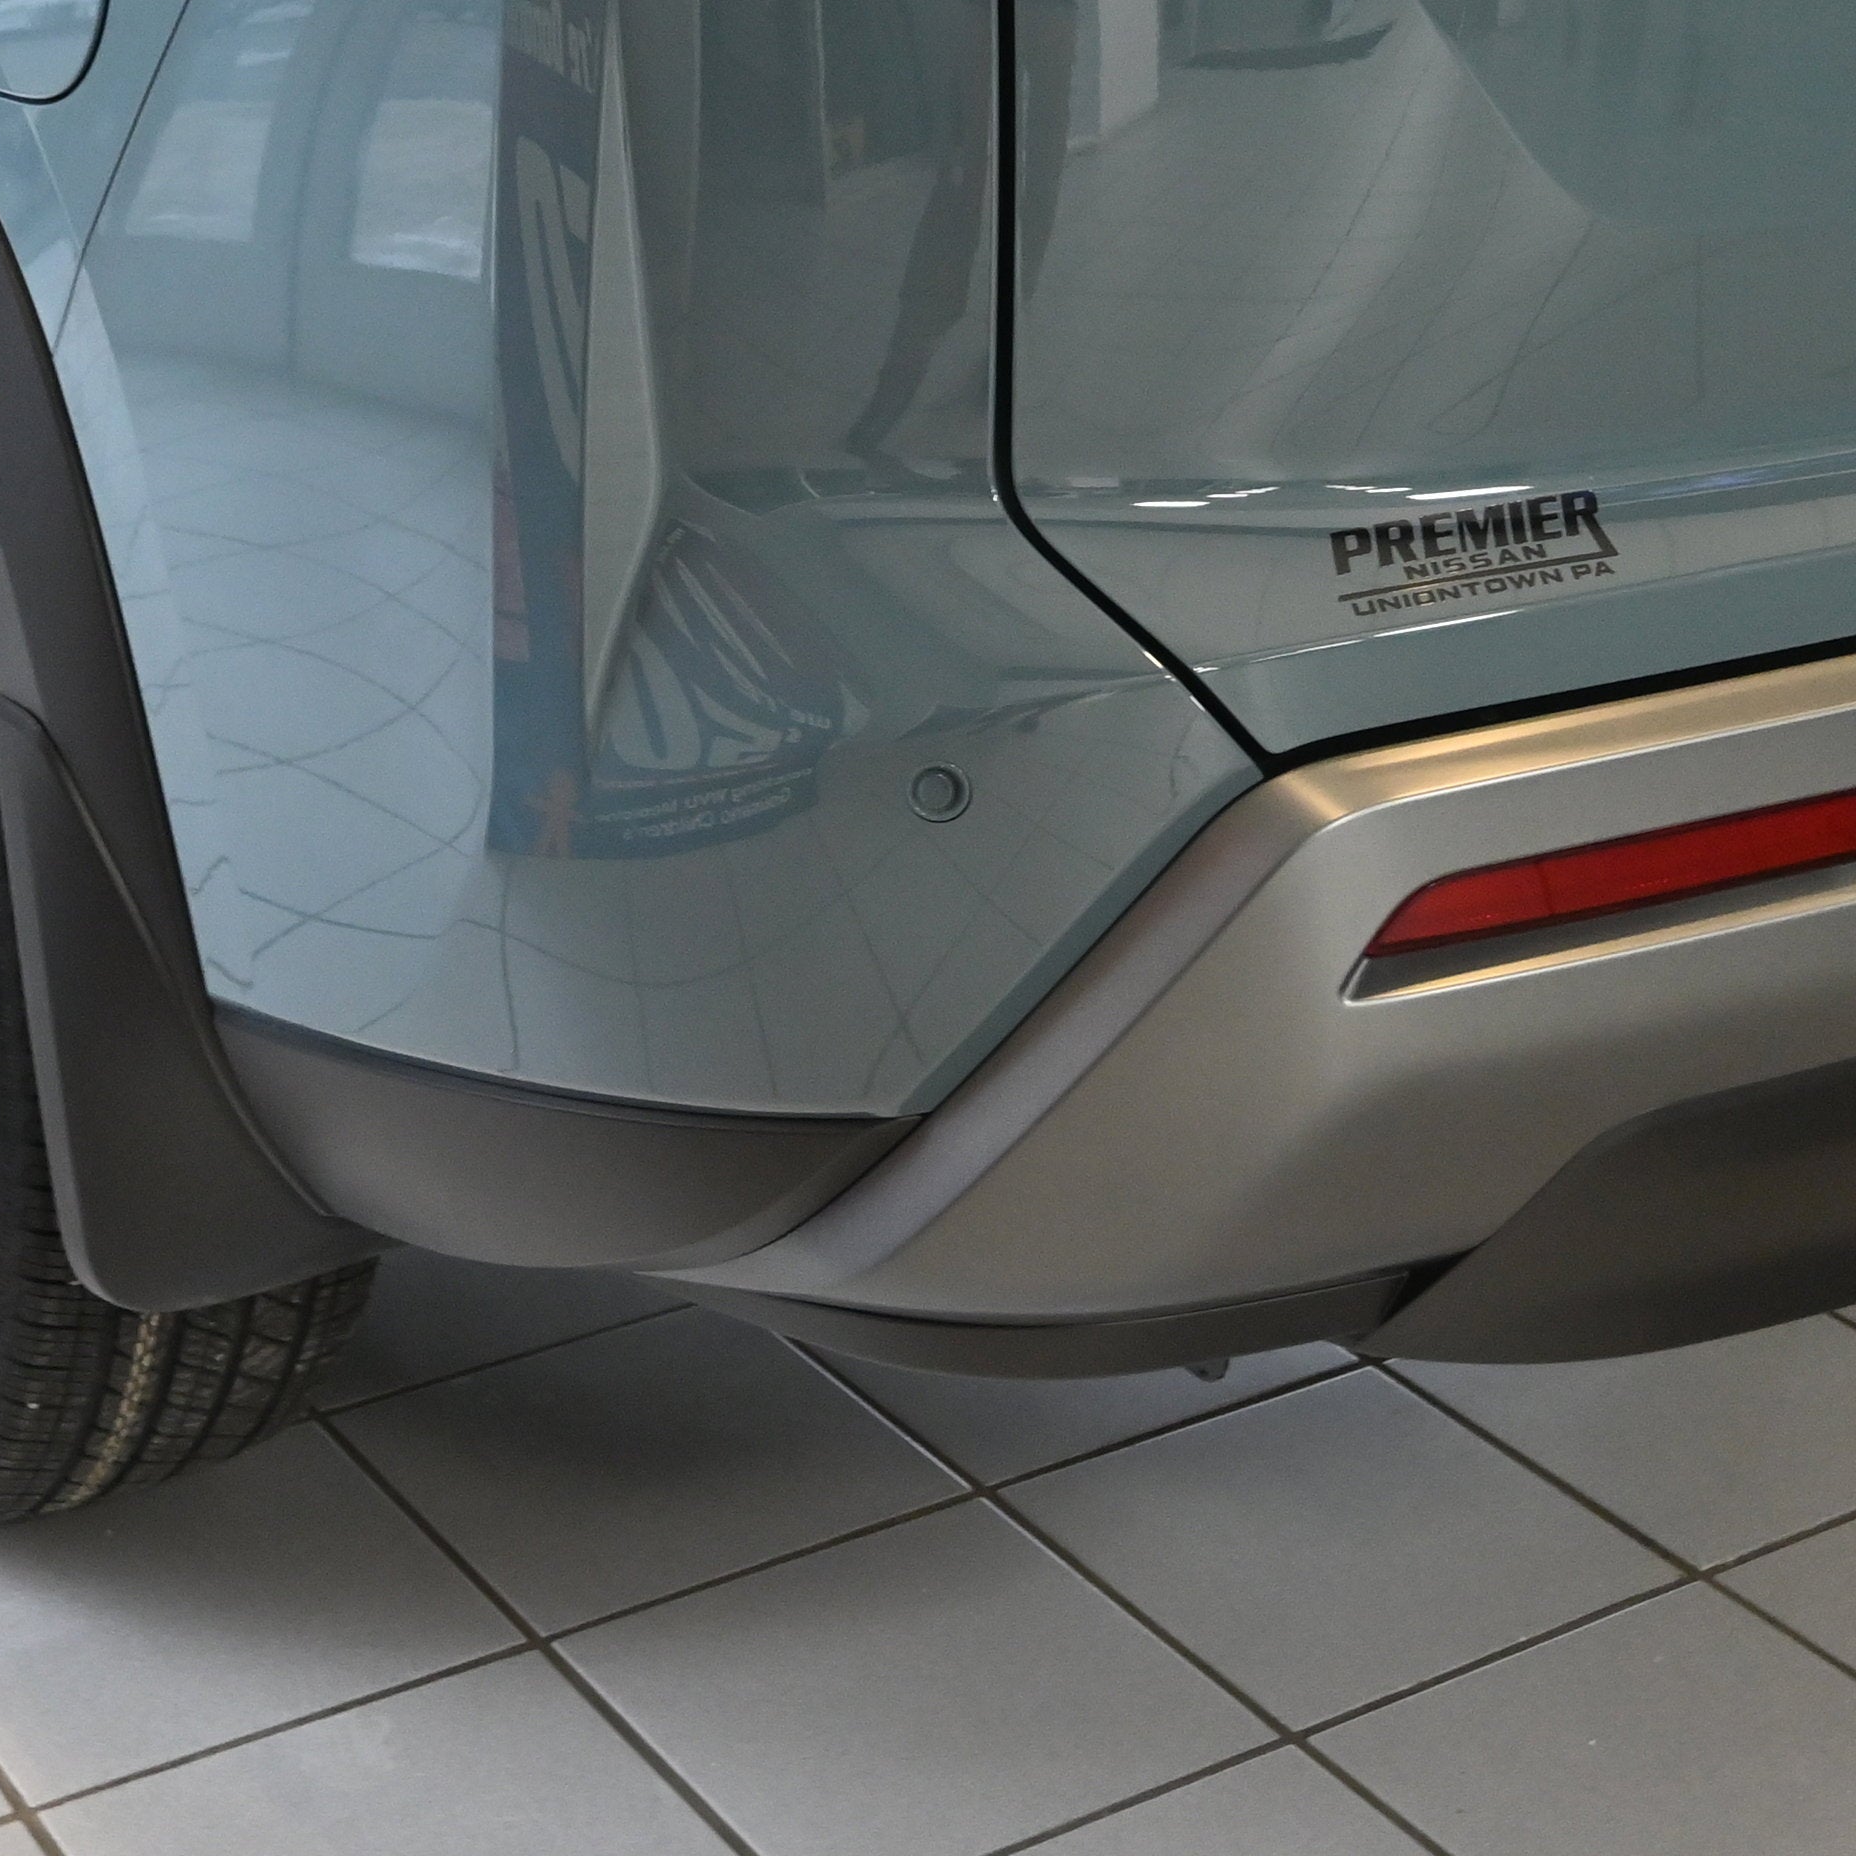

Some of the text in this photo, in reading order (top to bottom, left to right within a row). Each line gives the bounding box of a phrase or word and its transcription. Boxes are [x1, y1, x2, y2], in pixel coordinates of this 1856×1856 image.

[1328, 489, 1601, 576] PREMIER
[1403, 543, 1548, 581] NISSAN
[1350, 559, 1615, 618] UNIONTOWN PA
